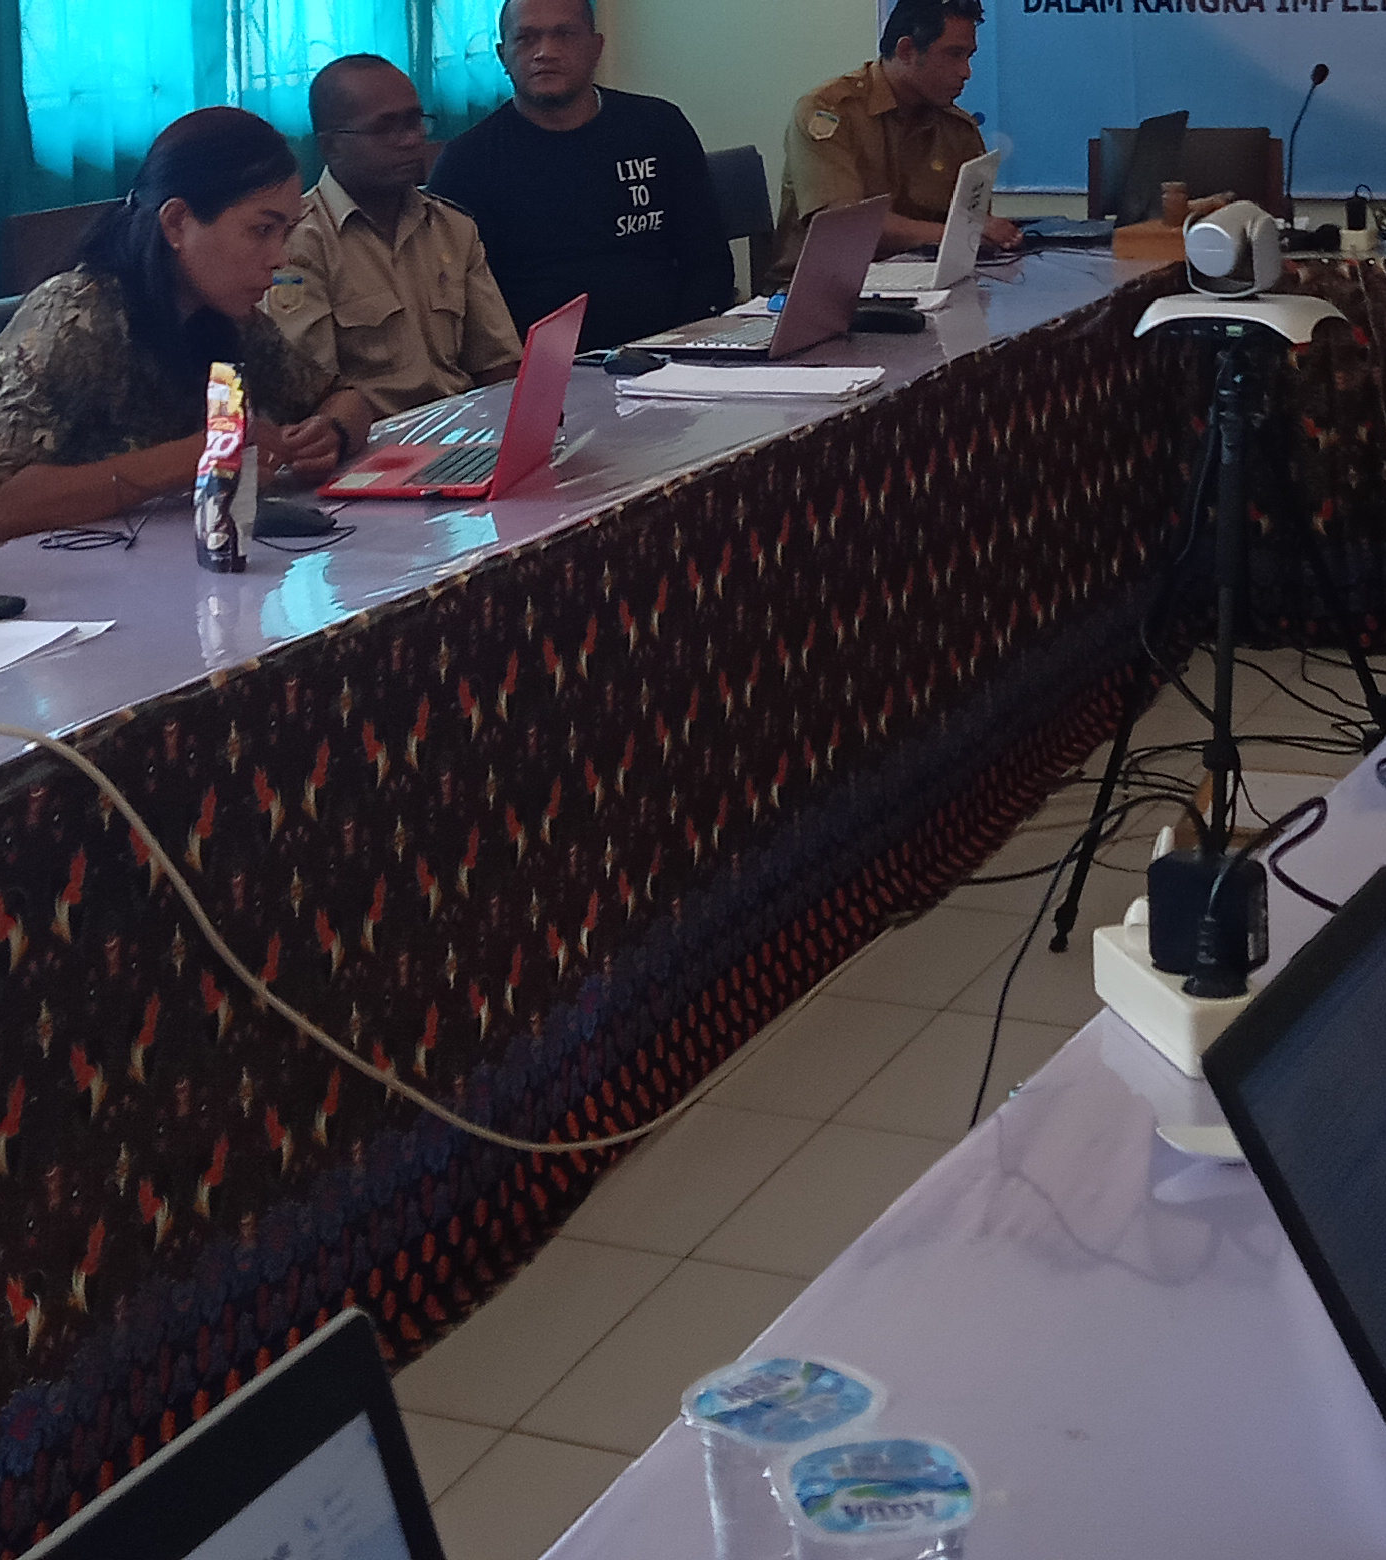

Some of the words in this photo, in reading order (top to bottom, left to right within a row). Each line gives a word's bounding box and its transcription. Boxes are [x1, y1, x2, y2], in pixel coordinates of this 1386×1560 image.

[616, 157, 657, 182] LIVE
[628, 184, 650, 207] TO
[616, 210, 665, 237] SKATE
